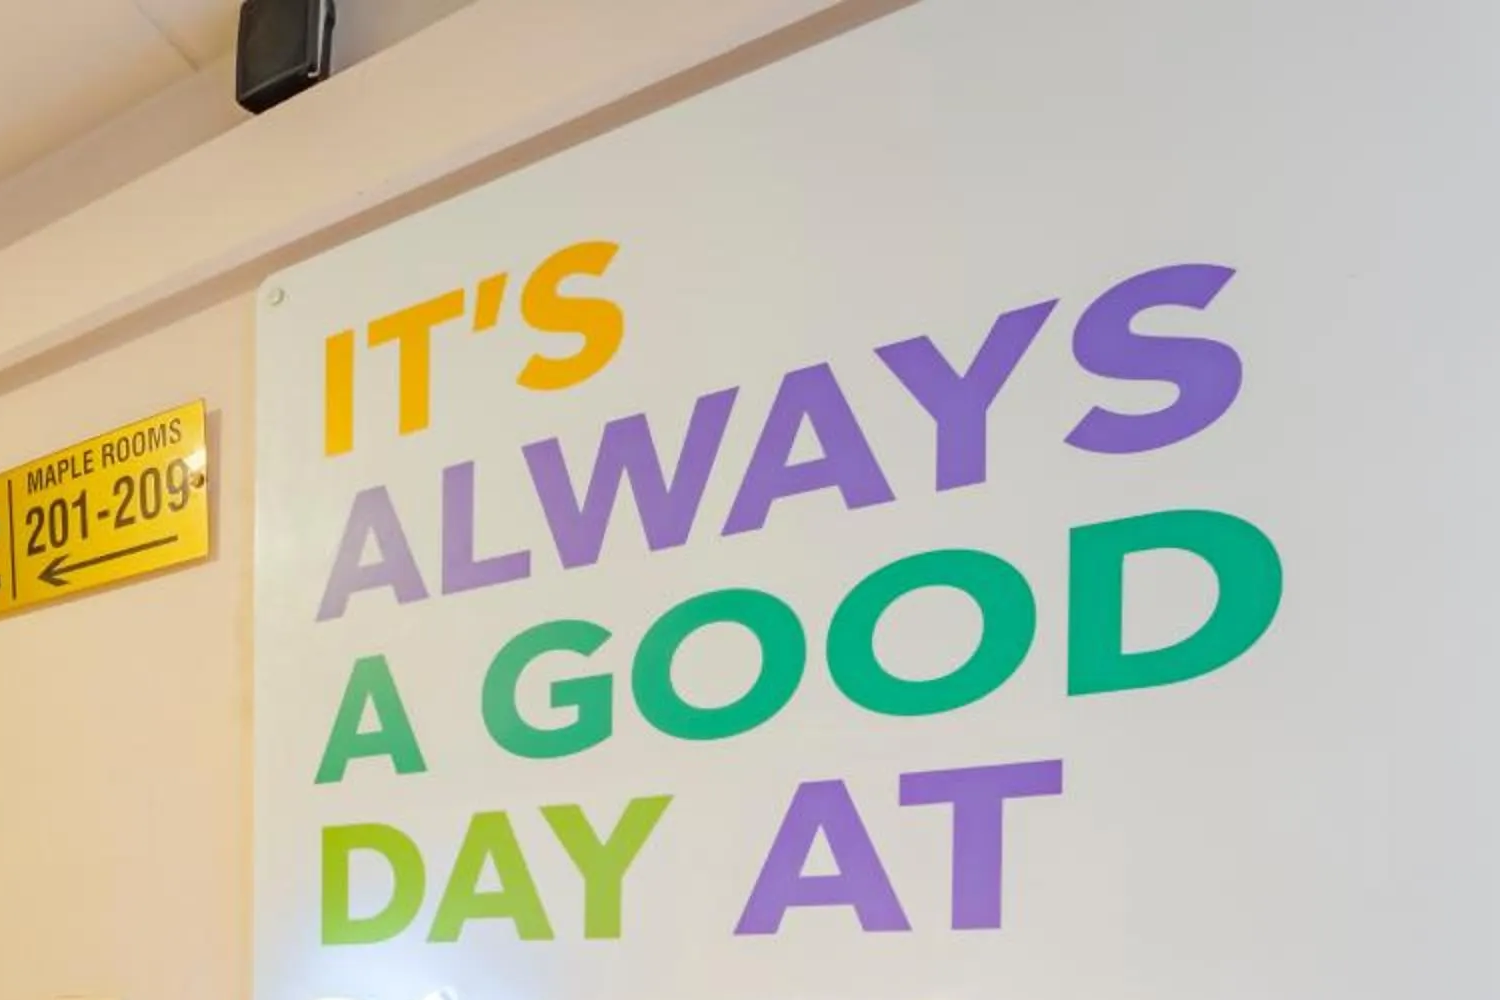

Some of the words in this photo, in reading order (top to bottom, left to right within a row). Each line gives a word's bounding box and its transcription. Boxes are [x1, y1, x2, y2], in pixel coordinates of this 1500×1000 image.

[314, 262, 1244, 623] ALWAYS
[322, 239, 625, 458] IT'S
[25, 457, 190, 556] 201-209
[26, 449, 95, 496] MAPLE
[101, 417, 182, 469] ROOMS
[313, 653, 428, 785] A
[481, 508, 1284, 760] GOOD
[320, 794, 674, 947] DAY
[733, 758, 1064, 936] AT
